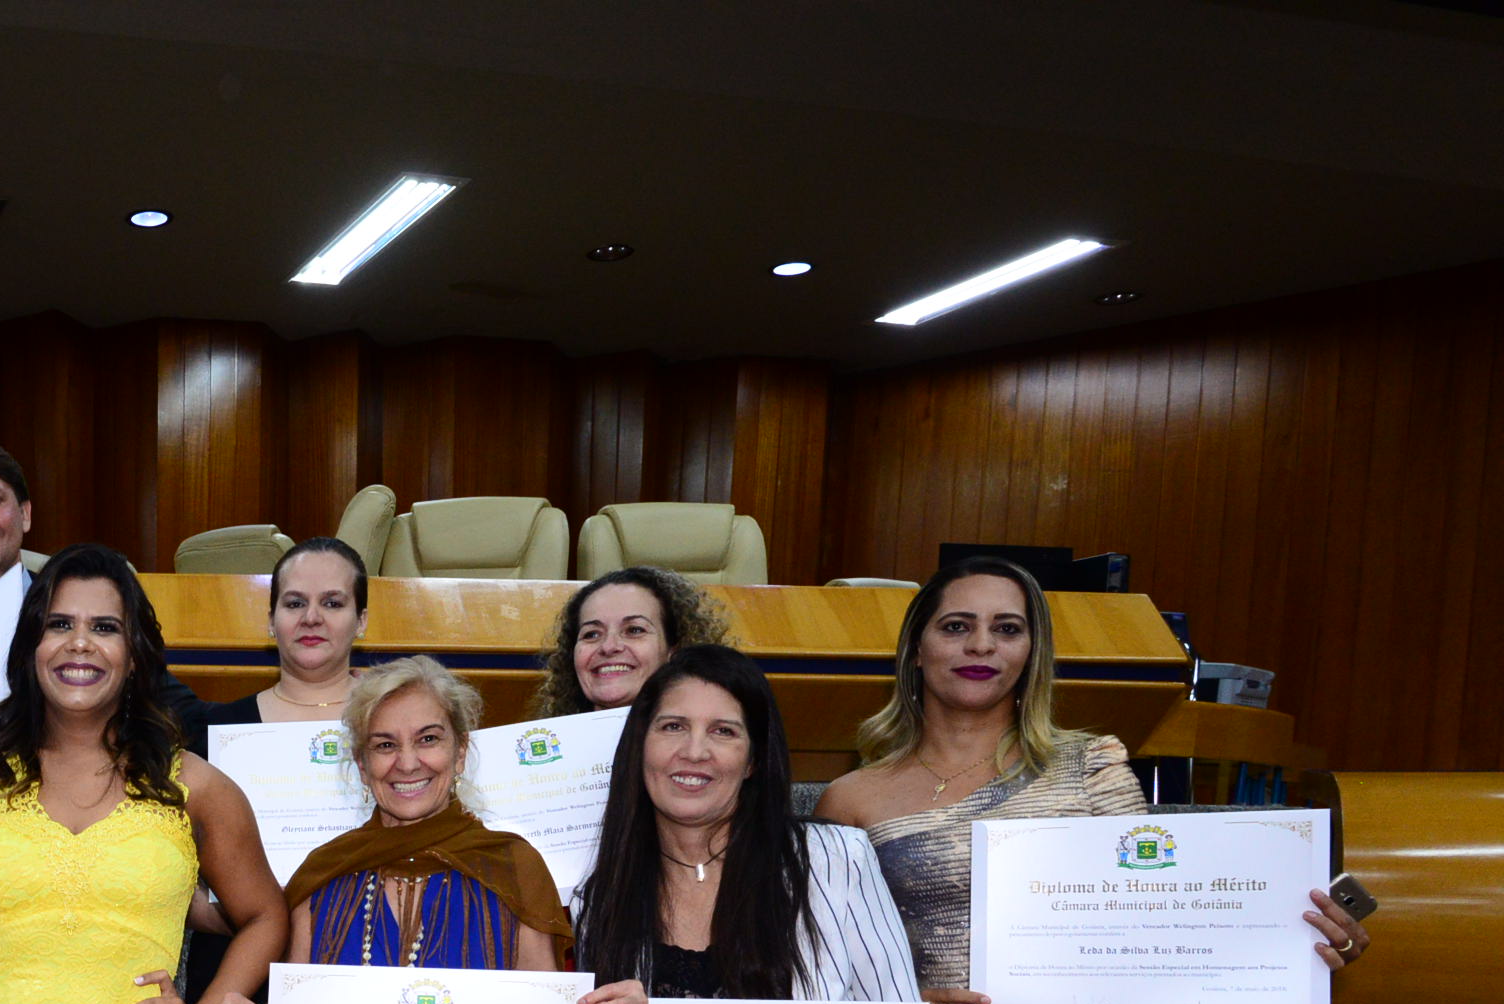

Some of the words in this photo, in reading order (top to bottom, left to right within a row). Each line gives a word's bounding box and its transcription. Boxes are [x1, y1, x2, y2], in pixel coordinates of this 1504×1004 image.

[1029, 879, 1095, 896] Diploma
[1101, 879, 1119, 893] de
[1126, 878, 1178, 894] Honra
[1183, 882, 1203, 893] ao
[1209, 876, 1268, 893] Mérito
[1051, 900, 1099, 912] Câmara
[1104, 899, 1167, 913] Municipal
[1173, 899, 1186, 911] de
[1191, 898, 1243, 911] Goiânia
[1119, 945, 1149, 955] Silva
